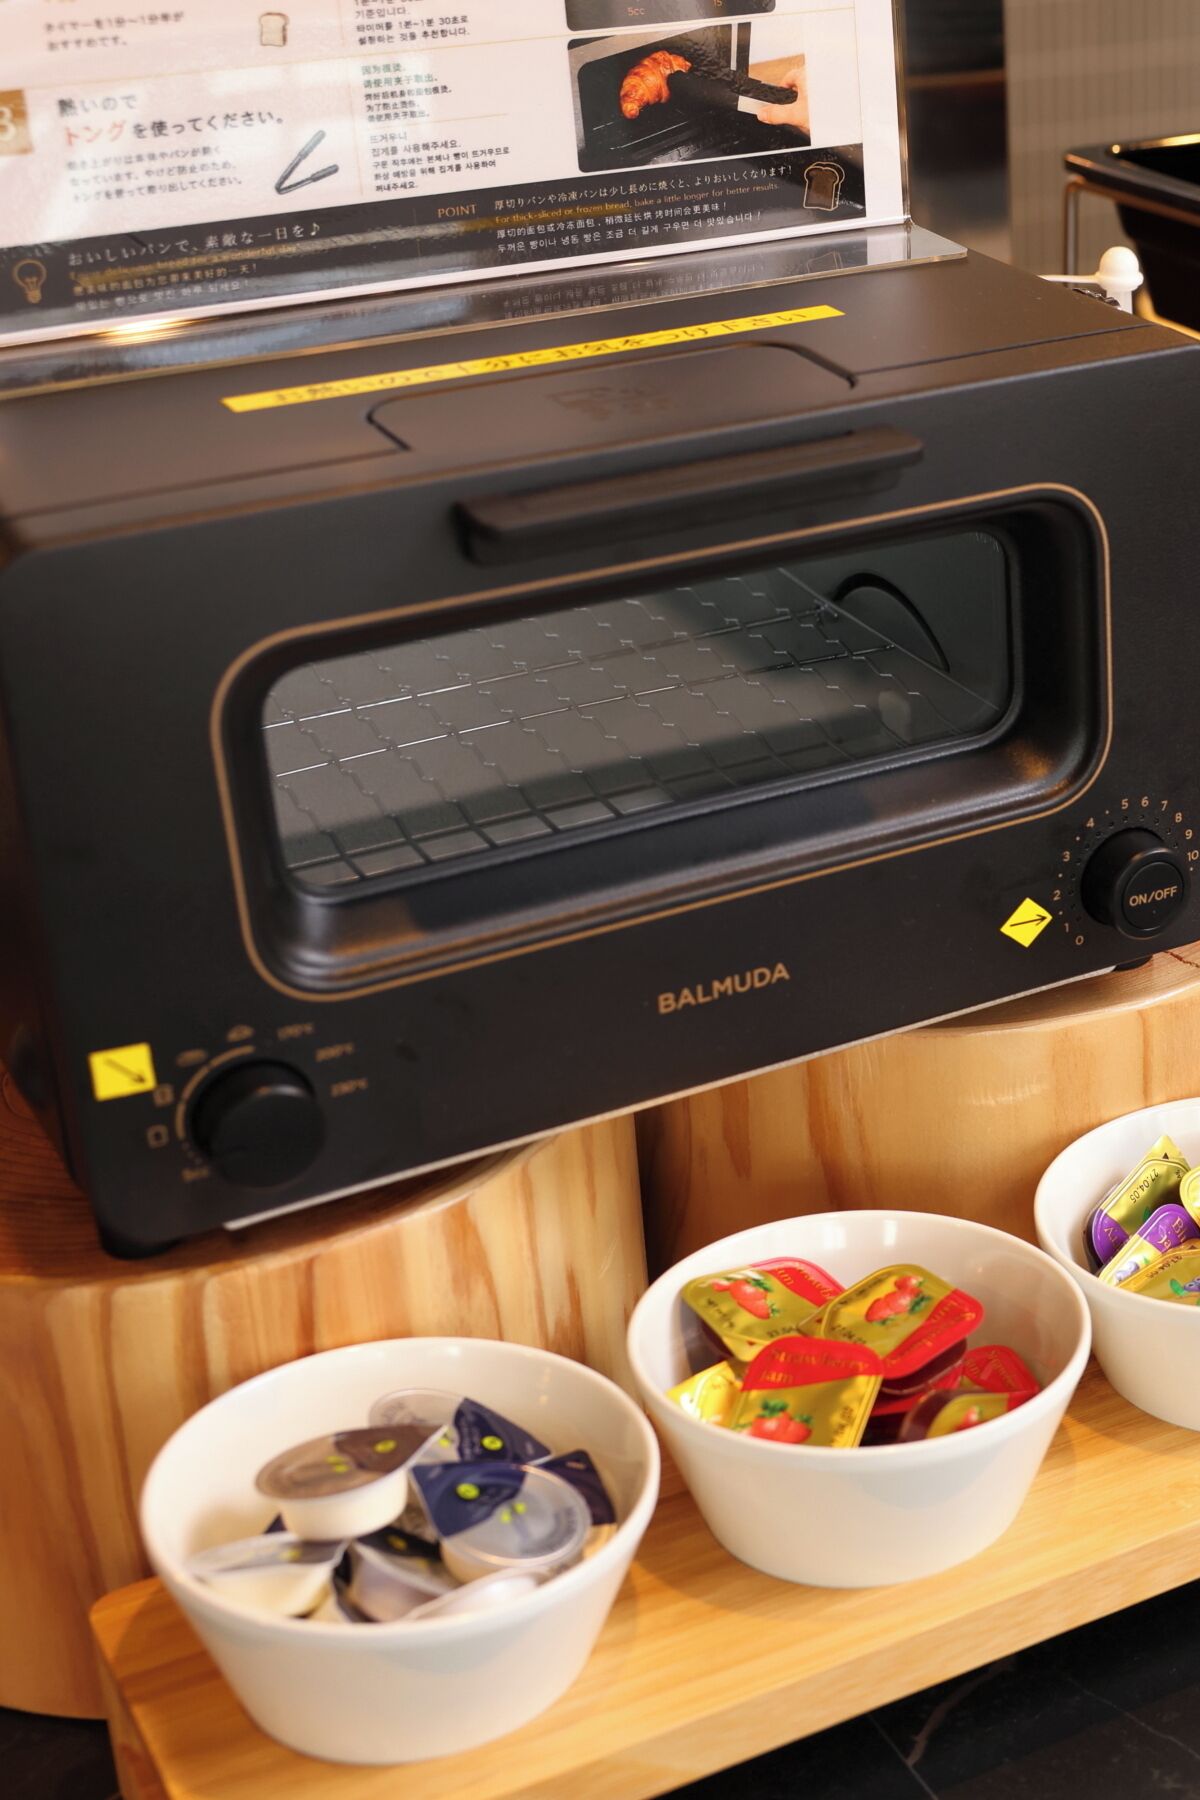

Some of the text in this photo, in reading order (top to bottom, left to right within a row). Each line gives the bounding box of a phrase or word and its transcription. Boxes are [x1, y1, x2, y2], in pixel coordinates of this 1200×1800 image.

[495, 215, 511, 225] For
[512, 209, 562, 223] thick-sliced
[564, 208, 574, 216] or
[576, 204, 603, 215] frozen
[605, 199, 633, 212] bread,
[634, 196, 654, 208] bake
[664, 193, 682, 204] little
[683, 190, 710, 204] longer
[711, 188, 724, 199] for
[726, 185, 750, 197] better
[752, 182, 779, 194] results.
[437, 204, 477, 218] POINT
[529, 237, 557, 250] 빵이나
[561, 234, 580, 246] 냉동
[583, 231, 601, 243] 빵은
[606, 229, 623, 240] 조금
[628, 227, 637, 237] 더
[642, 224, 659, 236] 길게
[663, 220, 690, 232] 구우면
[693, 218, 702, 228] 더
[1121, 799, 1129, 809] 5
[1141, 797, 1149, 807] 6
[1161, 800, 1168, 811] 7
[1086, 817, 1095, 828] 4
[1175, 813, 1183, 823] 8
[1185, 829, 1193, 840] 9
[1063, 851, 1071, 861] 3
[1187, 850, 1199, 861] 10
[1053, 890, 1061, 901] 2
[1129, 885, 1178, 907] ON/OFF
[1064, 923, 1070, 932] 1
[1075, 935, 1084, 945] 0
[658, 962, 790, 1014] BALMUDA
[1129, 1168, 1159, 1204] 27.04.05
